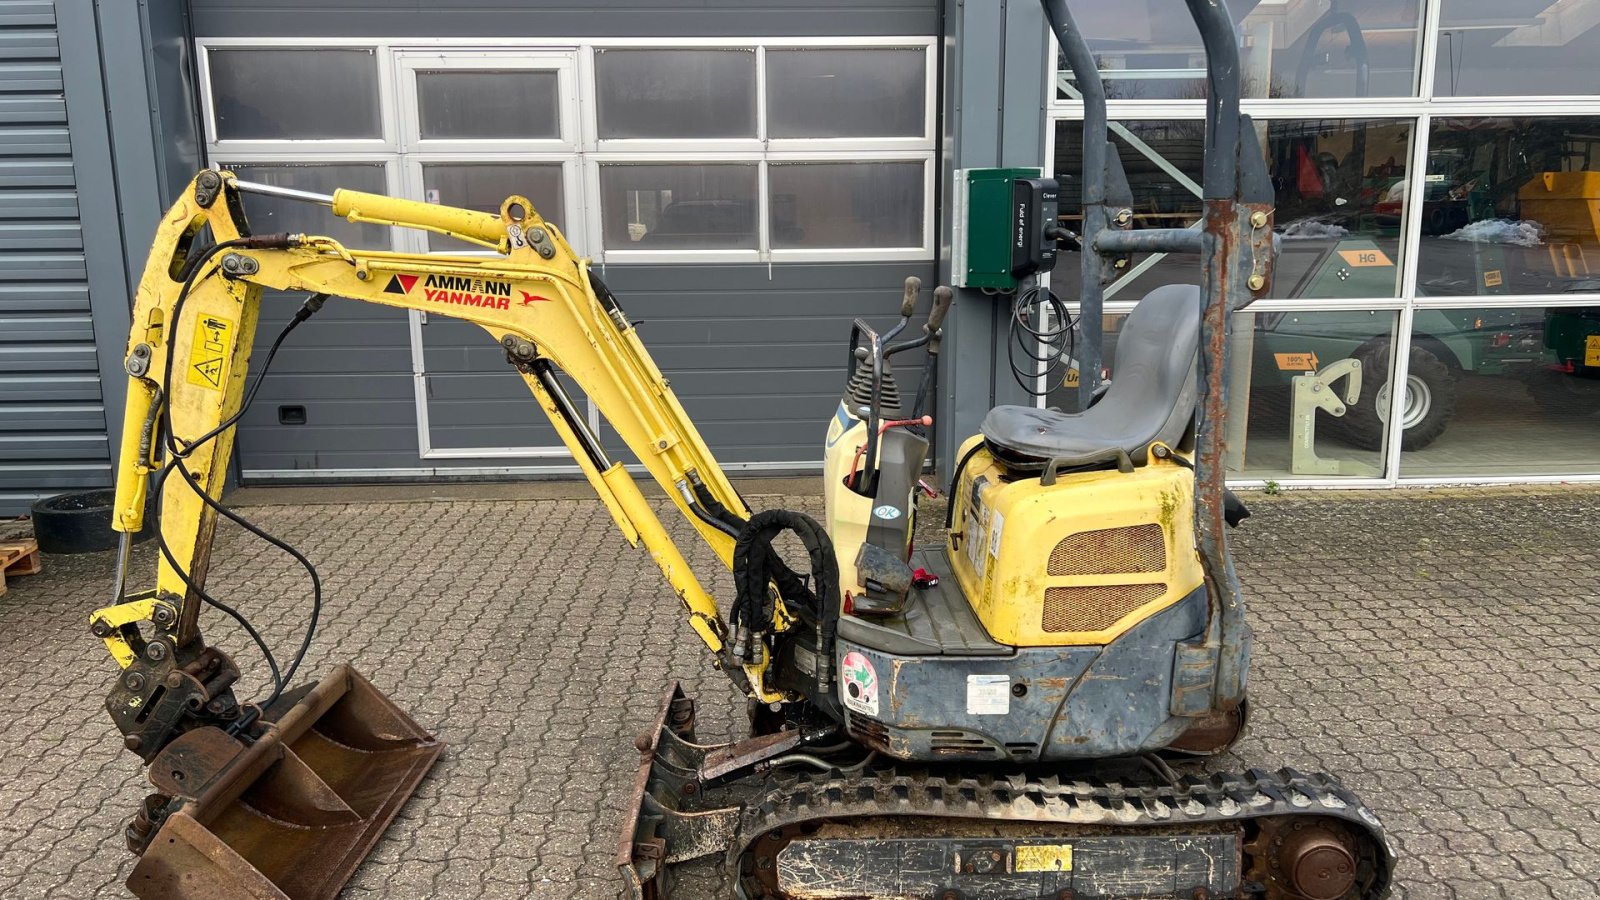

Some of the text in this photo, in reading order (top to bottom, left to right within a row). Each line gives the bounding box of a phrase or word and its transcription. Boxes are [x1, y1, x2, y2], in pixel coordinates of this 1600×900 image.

[1018, 218, 1025, 226] af
[1359, 253, 1376, 263] HG
[424, 274, 511, 297] AMMANN
[424, 288, 511, 310] YANMAR
[878, 507, 896, 518] OK
